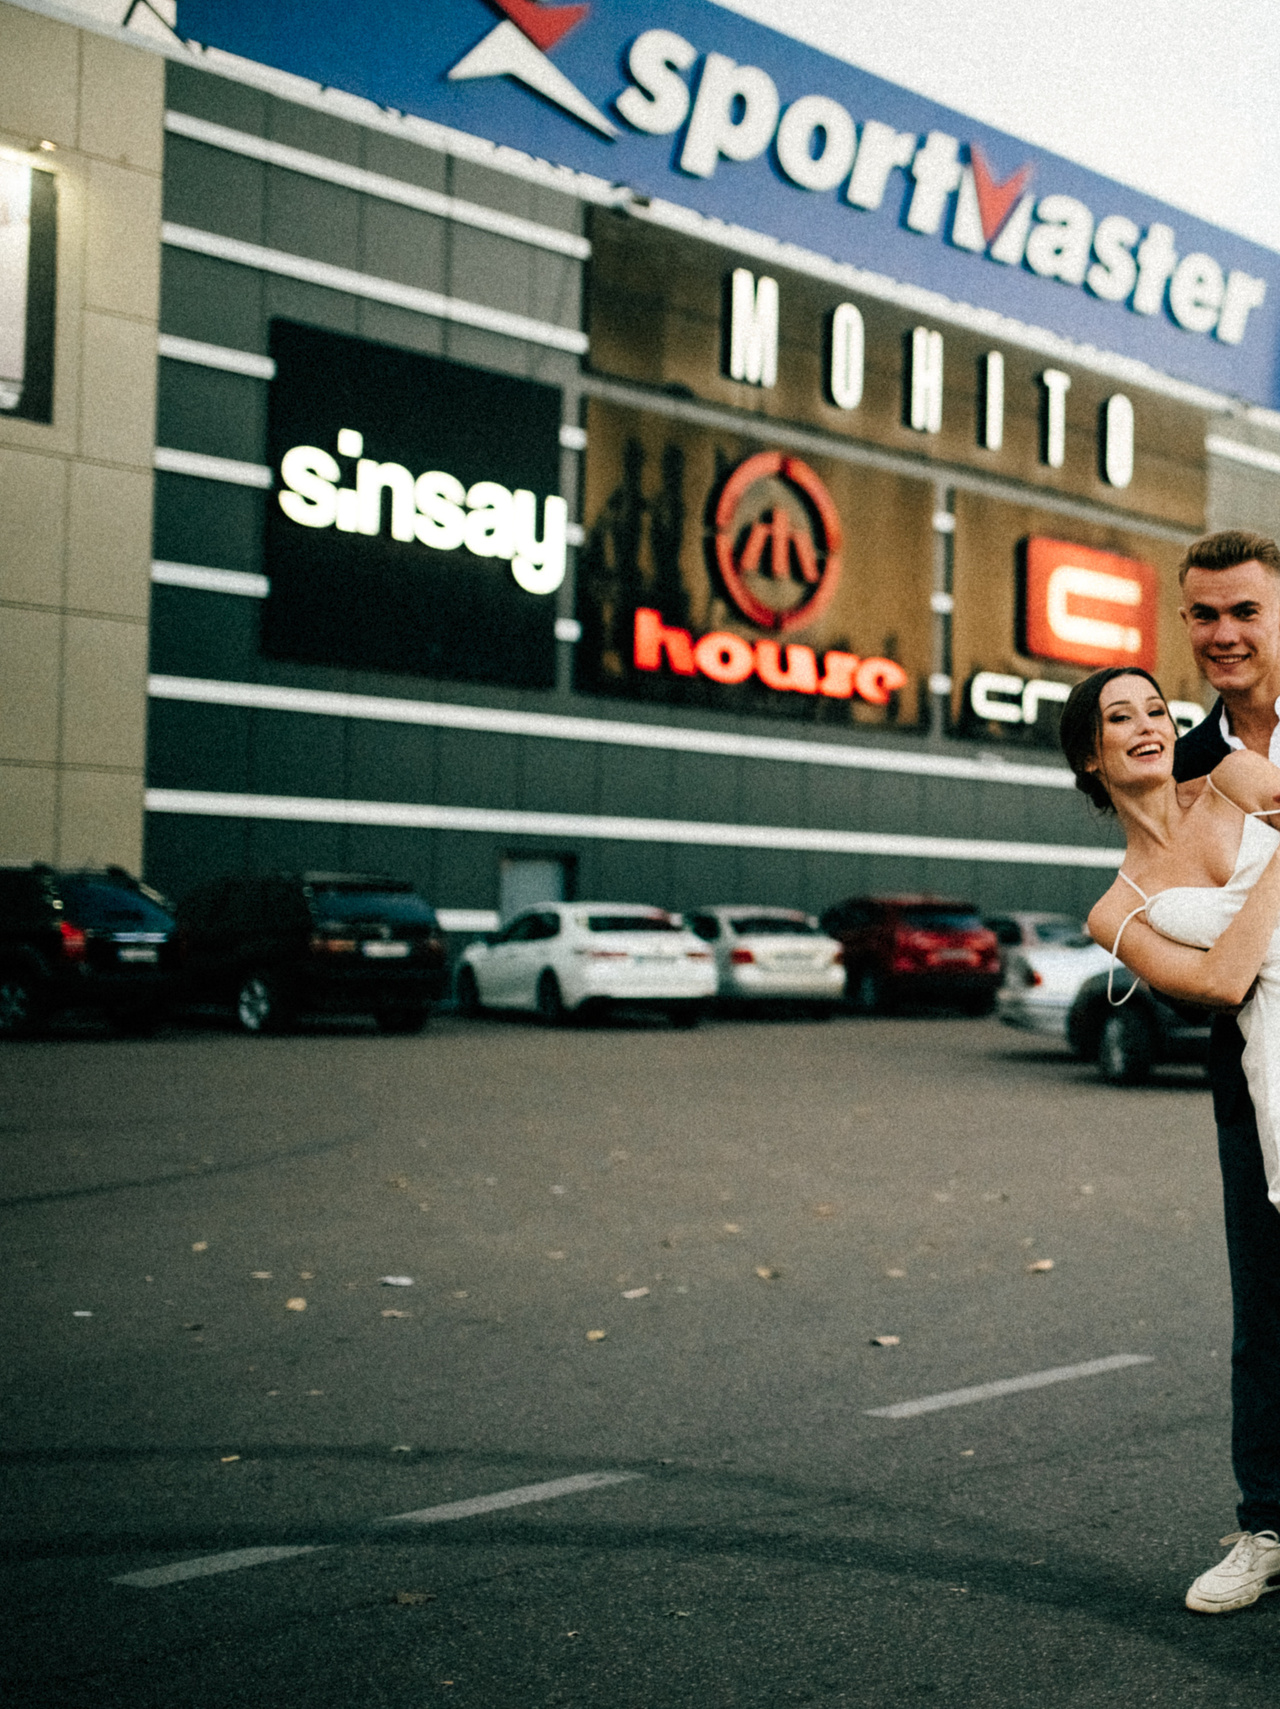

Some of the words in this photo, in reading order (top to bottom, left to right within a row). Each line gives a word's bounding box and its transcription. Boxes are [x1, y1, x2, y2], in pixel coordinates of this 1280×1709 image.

[729, 267, 1135, 490] MOHITO
[277, 428, 568, 595] sinsay
[634, 607, 908, 705] house
